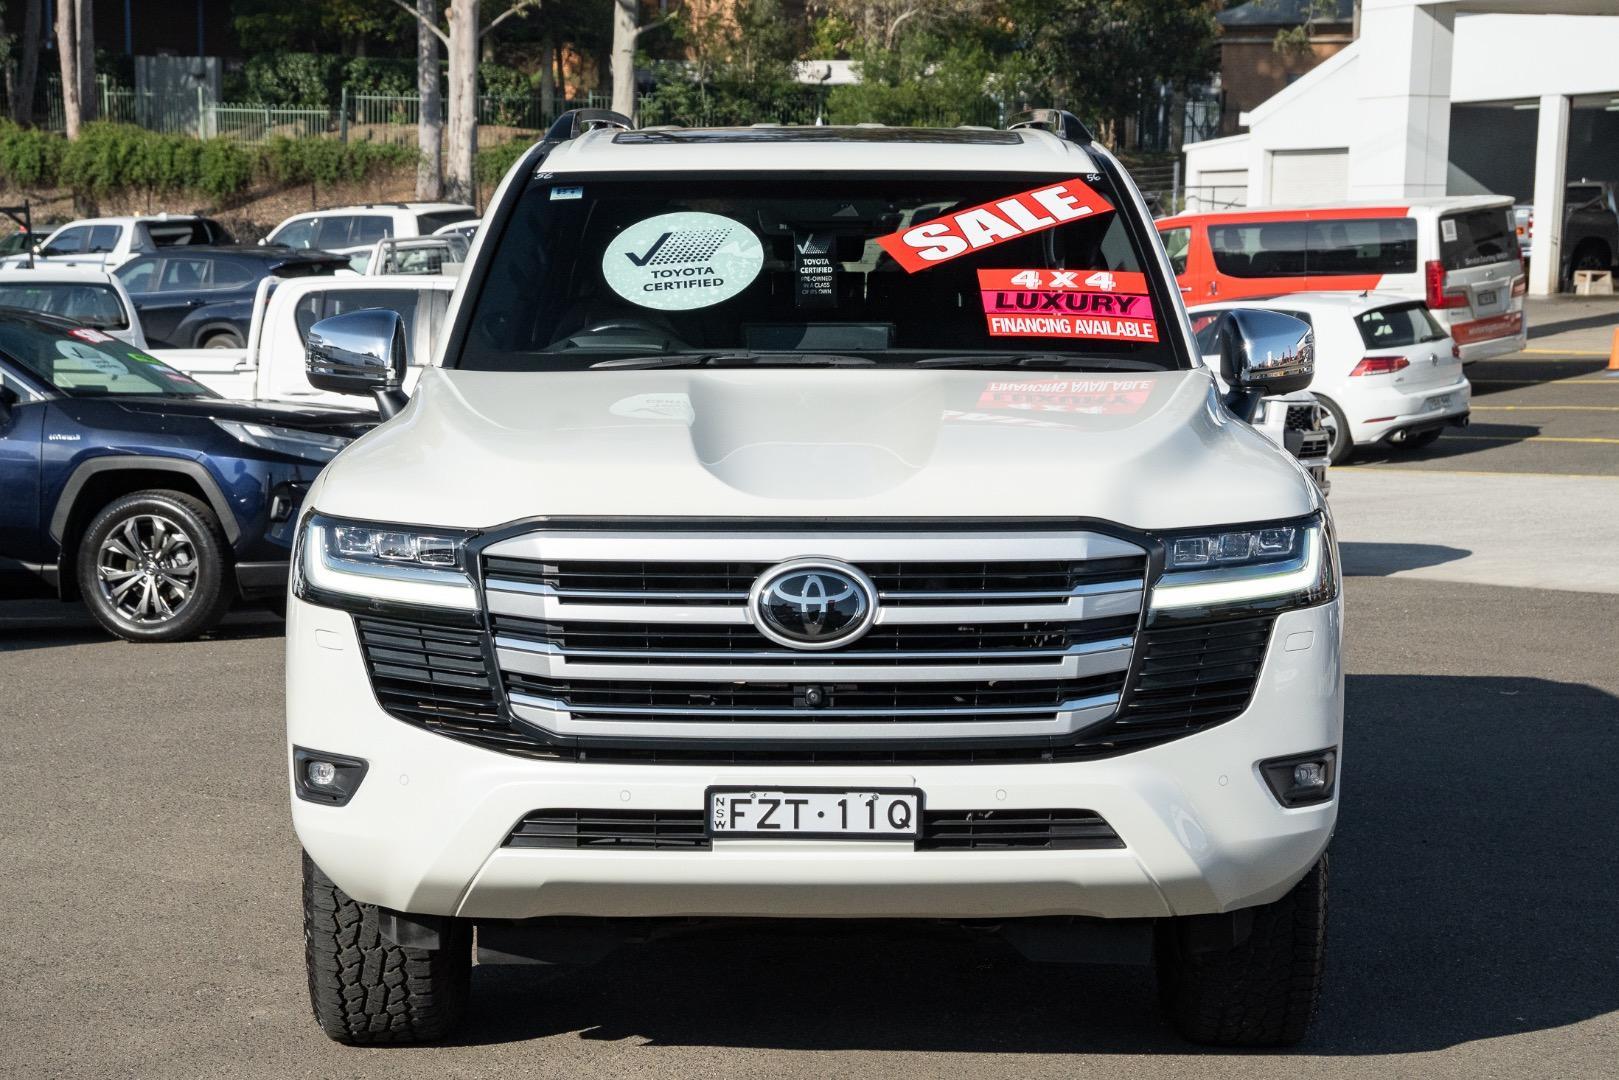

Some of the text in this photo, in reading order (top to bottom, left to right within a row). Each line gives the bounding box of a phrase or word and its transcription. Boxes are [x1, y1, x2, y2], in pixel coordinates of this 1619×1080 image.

[1086, 173, 1101, 182] 56
[902, 185, 1093, 262] SALE
[651, 266, 715, 279] TOYOTA
[1011, 270, 1042, 290] 4
[1085, 271, 1117, 292] 4
[643, 278, 724, 292] CERTIFIED
[995, 292, 1140, 313] LUXURY
[991, 317, 1154, 339] FINANCING AVAILABLE
[714, 797, 727, 830] NSW
